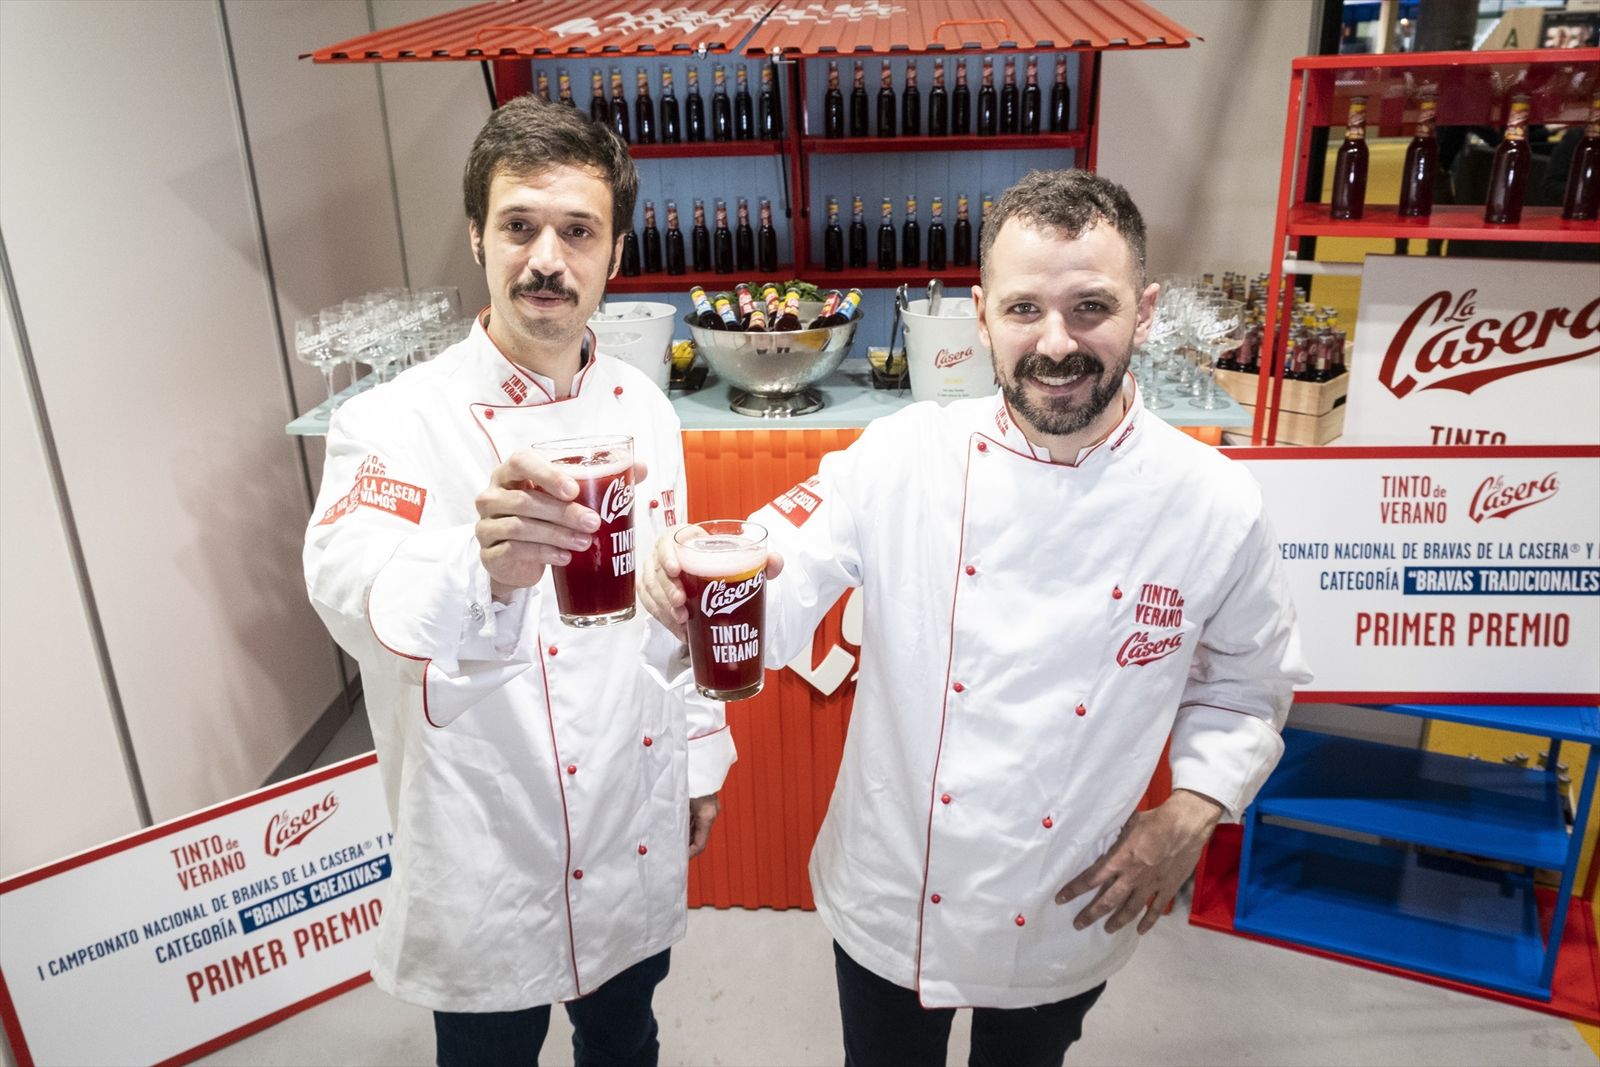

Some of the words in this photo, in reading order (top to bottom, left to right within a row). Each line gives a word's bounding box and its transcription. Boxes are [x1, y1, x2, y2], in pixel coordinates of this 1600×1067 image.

[1444, 289, 1477, 322] La
[934, 346, 975, 369] Casera
[362, 478, 378, 493] LA
[381, 481, 421, 506] CASERA
[1381, 475, 1431, 498] TINTO
[1433, 485, 1447, 498] de
[1468, 471, 1559, 524] Casera
[361, 490, 398, 512] VAMOS
[601, 478, 635, 524] Cas
[1381, 502, 1447, 524] VERANO
[610, 528, 635, 554] TINT
[1279, 543, 1329, 560] EONATO
[1334, 543, 1397, 560] NACIONAL
[1402, 543, 1418, 560] DE
[1424, 543, 1472, 560] BRAVAS
[1477, 543, 1493, 560] DE
[1499, 543, 1514, 560] LA
[1586, 543, 1594, 560] Y
[612, 551, 635, 577] VER
[701, 567, 764, 618] Casera
[1320, 567, 1399, 591] CATEGORÍA
[1479, 571, 1600, 592] TRADICIONALES
[1140, 584, 1179, 607] TINTO
[1135, 604, 1183, 628] VERANO
[1356, 612, 1456, 647] PRIMER
[1467, 612, 1571, 648] PREMIO
[710, 623, 749, 644] TINTO
[712, 639, 759, 663] VERANO
[1116, 631, 1185, 668] Casera
[264, 791, 340, 857] Casera
[170, 834, 224, 869] TINTO
[226, 838, 240, 851] de
[177, 851, 247, 892] VERANO
[37, 965, 45, 981] I
[48, 929, 140, 977] CAMPEONATO
[142, 903, 208, 939] NACIONAL
[211, 894, 229, 913] DE
[232, 875, 279, 906] BRAVAS
[282, 867, 299, 886] DE
[301, 860, 317, 879] LA
[376, 836, 384, 850] Y
[155, 918, 238, 964] CATEGORÍA
[186, 938, 288, 1004] PRIMER
[293, 898, 383, 959] PREMIO
